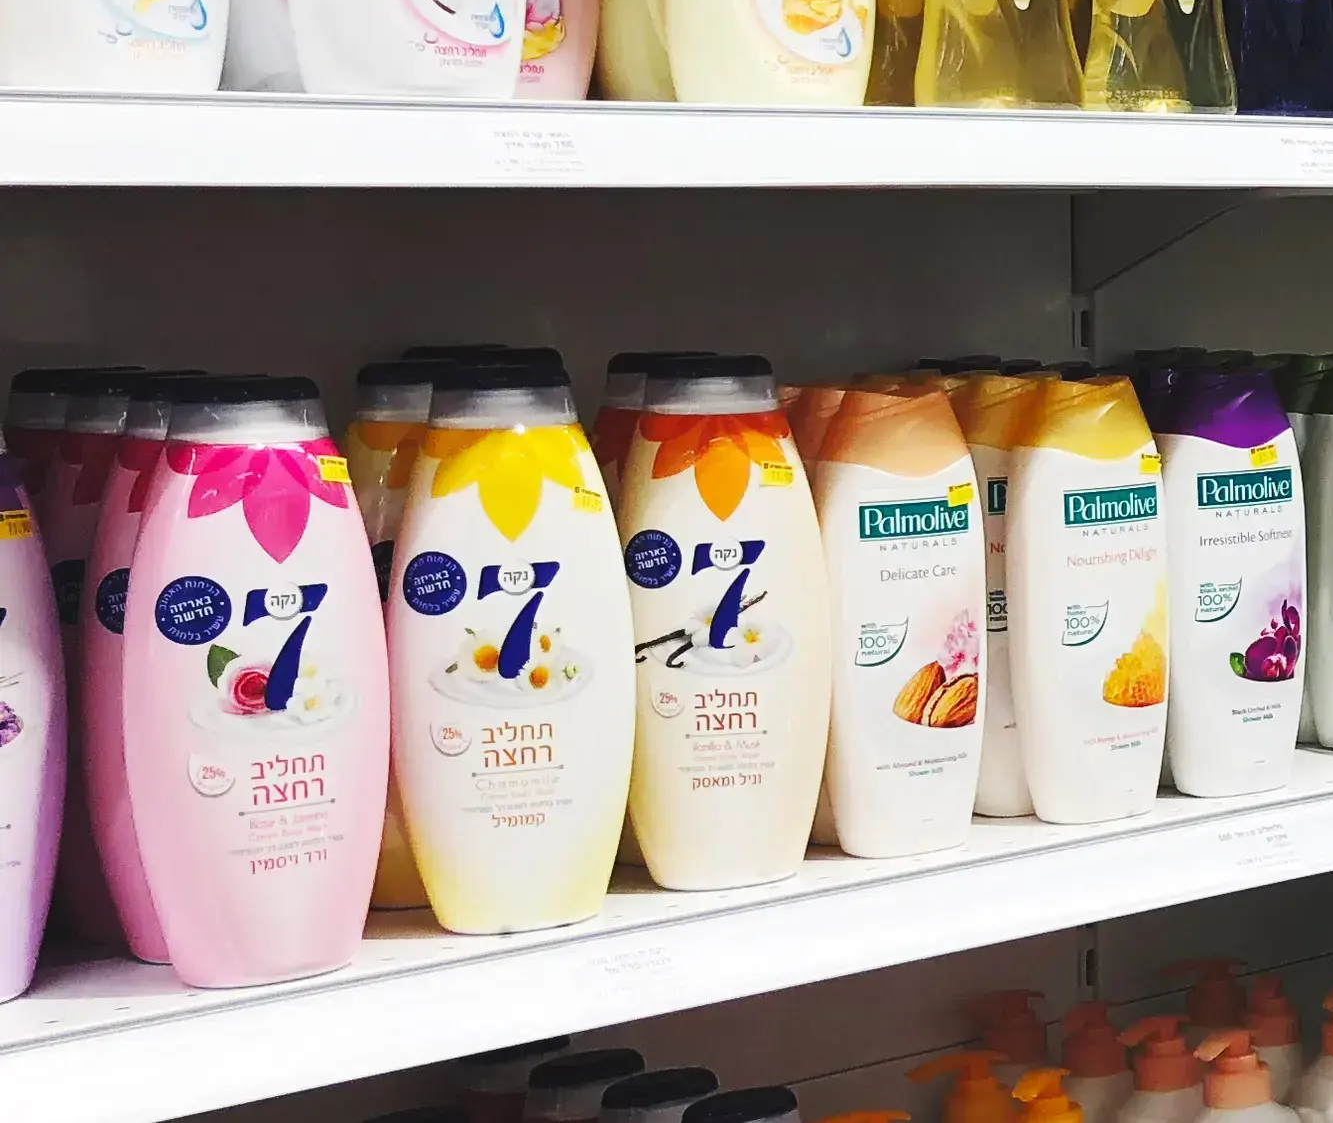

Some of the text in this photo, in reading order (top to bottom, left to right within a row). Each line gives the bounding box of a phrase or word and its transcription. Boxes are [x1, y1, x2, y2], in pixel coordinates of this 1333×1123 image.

[1202, 478, 1291, 503] Palmolive
[1069, 495, 1156, 520] Palmolive
[1215, 506, 1282, 518] NATURALS
[864, 509, 966, 535] Palmolive
[1082, 524, 1148, 537] NATURALS
[880, 538, 957, 552] NATURALS
[1200, 532, 1256, 547] Irresistible
[635, 547, 667, 561] באריזה
[714, 549, 738, 559] נקה
[1067, 551, 1127, 568] Nourishing
[637, 556, 668, 569] חדשה
[414, 570, 449, 585] באריזה
[503, 570, 529, 584] נקה
[881, 563, 956, 582] Delicate Care
[416, 580, 451, 595] חדשה
[691, 540, 766, 649] 7
[170, 595, 213, 614] באריזה
[270, 593, 296, 608] נקה
[1197, 593, 1233, 606] 100%
[174, 606, 214, 624] חדשה
[477, 561, 560, 679] 7
[1064, 615, 1100, 629] 100%
[1067, 628, 1094, 636] natural
[243, 583, 328, 712] 7
[858, 635, 898, 649] 100%
[861, 648, 890, 656] natural
[694, 690, 758, 708] תחליב
[696, 711, 757, 731] רחצה
[481, 721, 553, 744] תחליב
[484, 744, 552, 767] רחצה
[251, 754, 325, 780] תחליב
[692, 773, 762, 790] וניל ומאסק
[253, 778, 325, 806] רחצה
[492, 812, 545, 828] קמומיל
